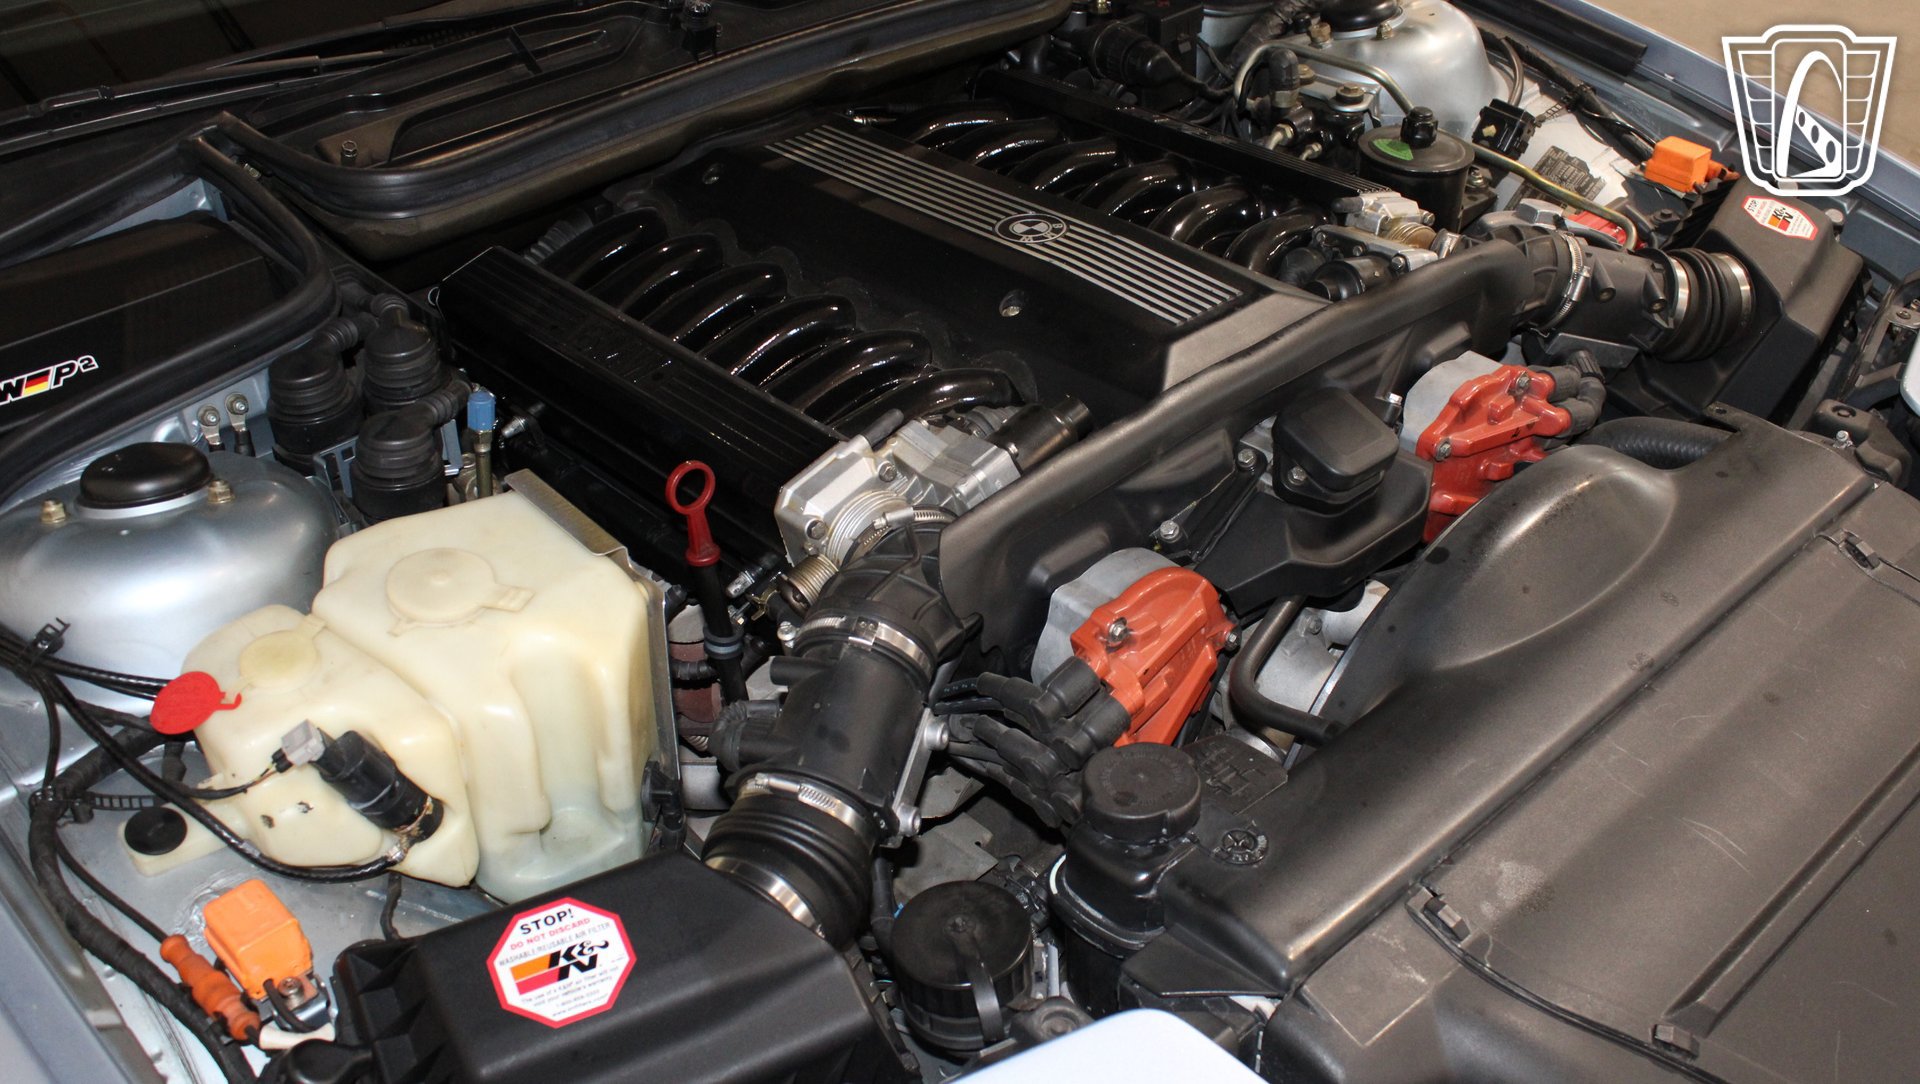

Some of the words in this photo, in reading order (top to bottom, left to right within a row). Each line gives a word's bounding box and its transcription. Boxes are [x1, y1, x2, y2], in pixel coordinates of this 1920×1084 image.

[510, 942, 524, 951] DO
[527, 933, 546, 944] NOT
[549, 917, 591, 937] DISCARD
[520, 908, 574, 935] STOP!
[589, 922, 611, 935] FILTER
